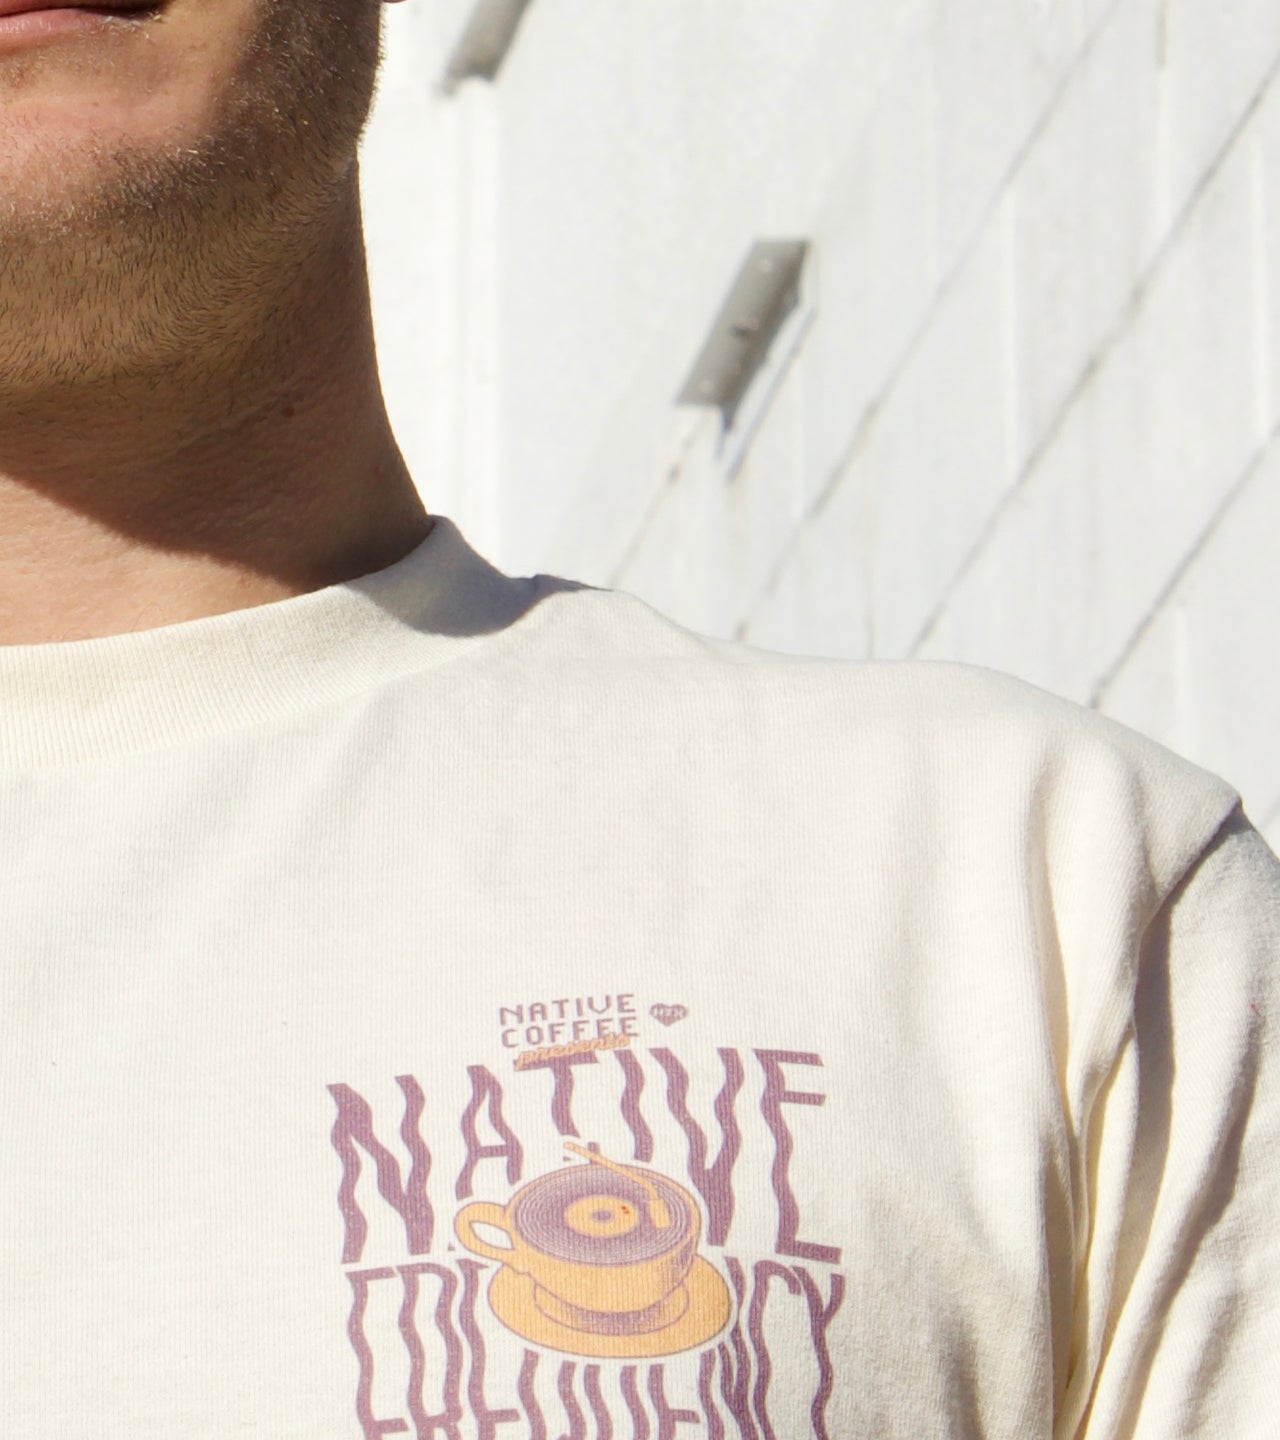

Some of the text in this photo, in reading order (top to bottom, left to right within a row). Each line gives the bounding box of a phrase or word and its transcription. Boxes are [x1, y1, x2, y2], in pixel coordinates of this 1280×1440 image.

[499, 993, 636, 1026] NATIVE
[501, 1016, 639, 1048] COFFEE
[326, 1046, 843, 1265] NATIVE
